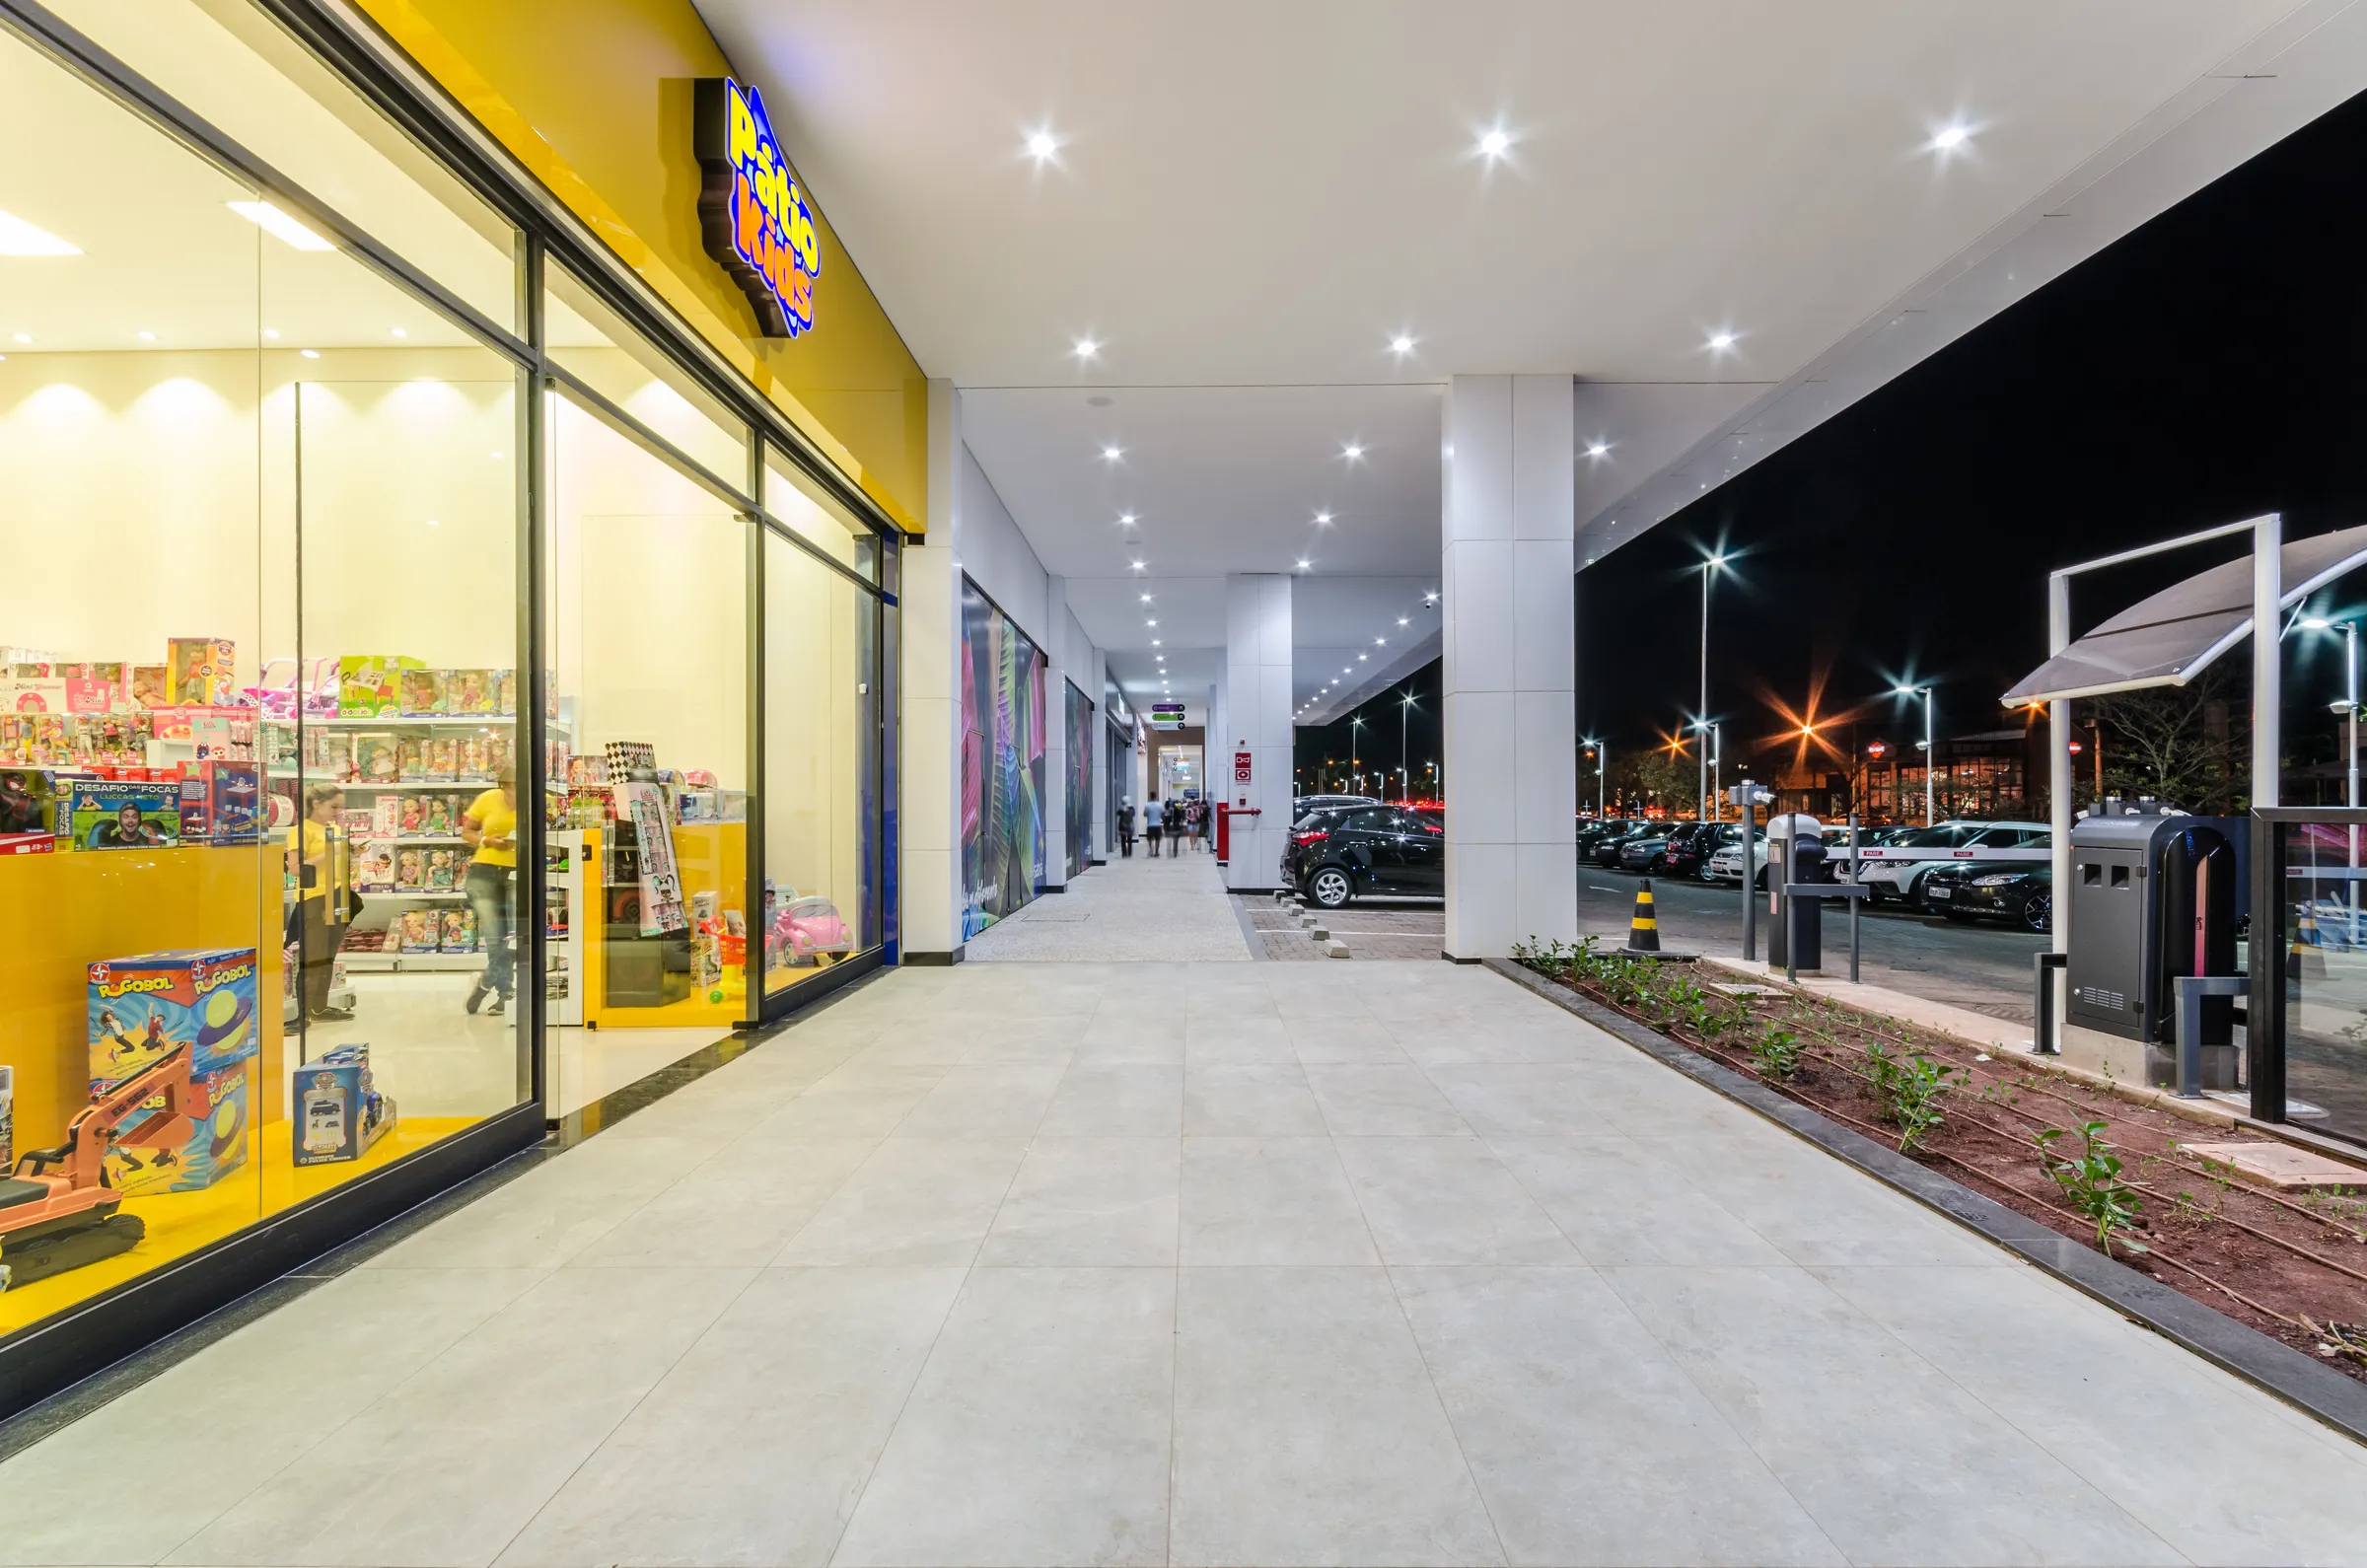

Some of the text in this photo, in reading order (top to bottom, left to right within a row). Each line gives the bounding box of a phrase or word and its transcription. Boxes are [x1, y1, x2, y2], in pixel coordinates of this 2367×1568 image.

[730, 86, 819, 273] Pátio
[75, 783, 128, 792] DESAFIO
[141, 785, 179, 794] FOCAS
[110, 1087, 150, 1117] EG-562
